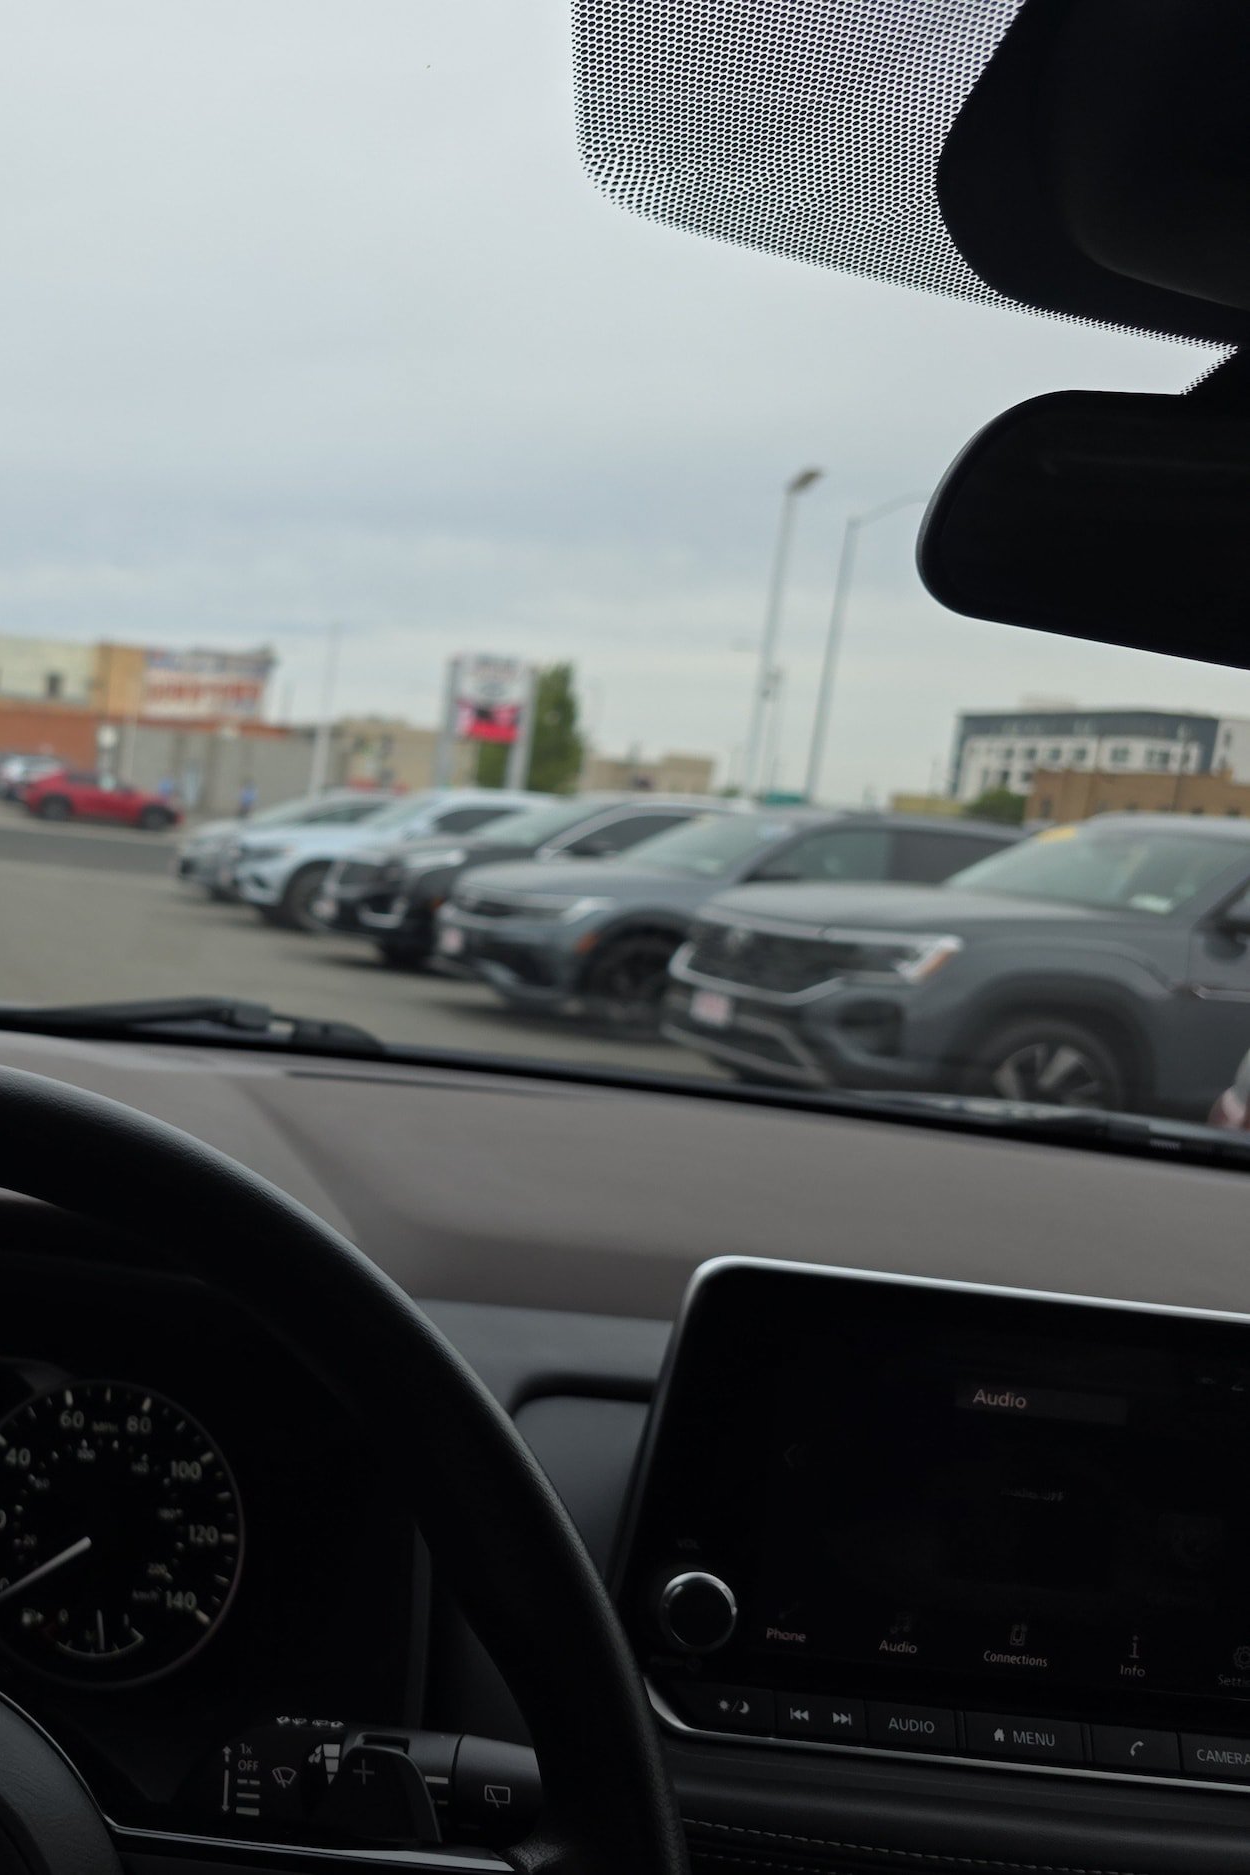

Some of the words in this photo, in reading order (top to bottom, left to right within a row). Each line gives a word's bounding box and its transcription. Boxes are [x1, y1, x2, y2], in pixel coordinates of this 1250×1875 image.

[973, 1388, 1027, 1409] Audio
[59, 1409, 85, 1431] 60
[125, 1415, 152, 1436] 80
[5, 1448, 31, 1469] 40
[170, 1459, 202, 1482] 100
[187, 1524, 219, 1546] 120
[165, 1590, 196, 1613] 140
[765, 1626, 807, 1643] Phone
[878, 1638, 919, 1654] Audio
[982, 1649, 1048, 1668] Connections
[1119, 1663, 1146, 1679] Info
[887, 1715, 935, 1734] AUDIO
[1012, 1729, 1056, 1747] MENU
[237, 1759, 260, 1772] OFF
